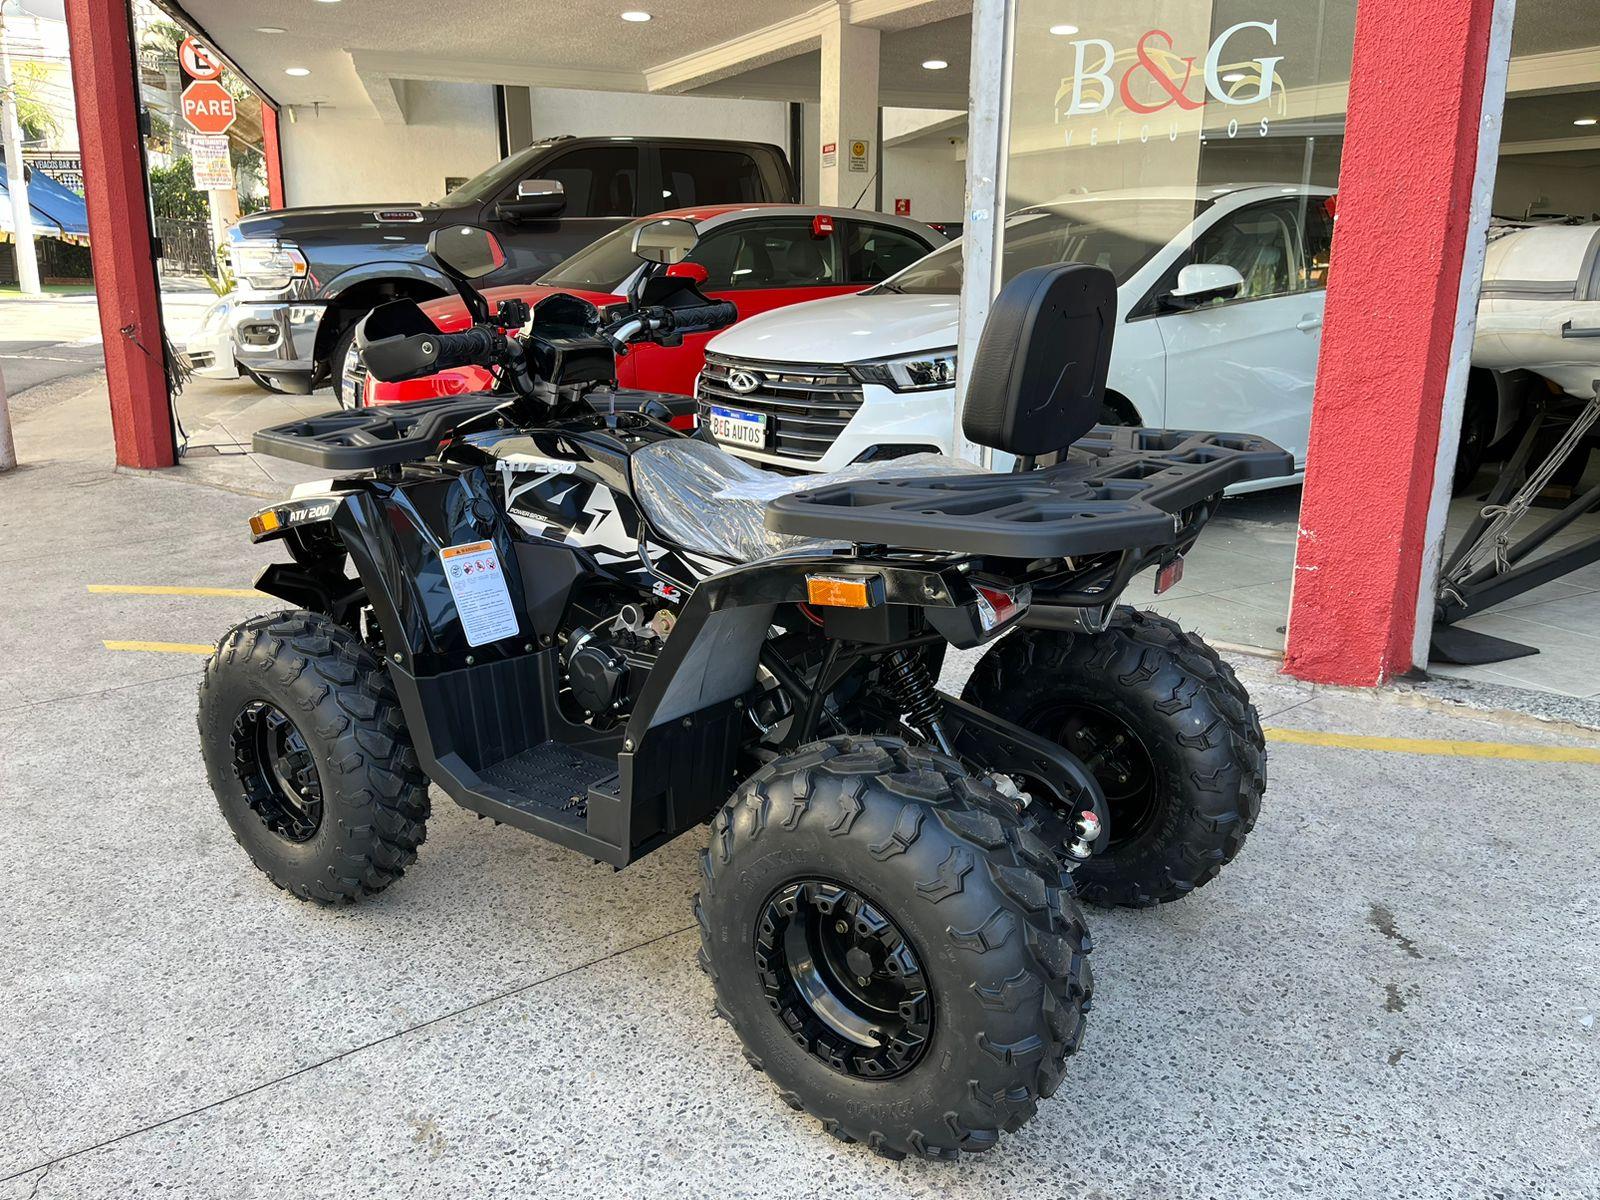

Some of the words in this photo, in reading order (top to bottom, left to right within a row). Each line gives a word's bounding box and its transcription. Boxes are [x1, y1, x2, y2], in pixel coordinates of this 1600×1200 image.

[1064, 19, 1284, 116] B&G
[185, 100, 232, 116] PARE
[59, 160, 70, 168] BAR
[714, 418, 730, 437] BEG
[732, 424, 760, 443] AUTOS
[290, 509, 308, 522] ATV
[309, 505, 330, 518] 200
